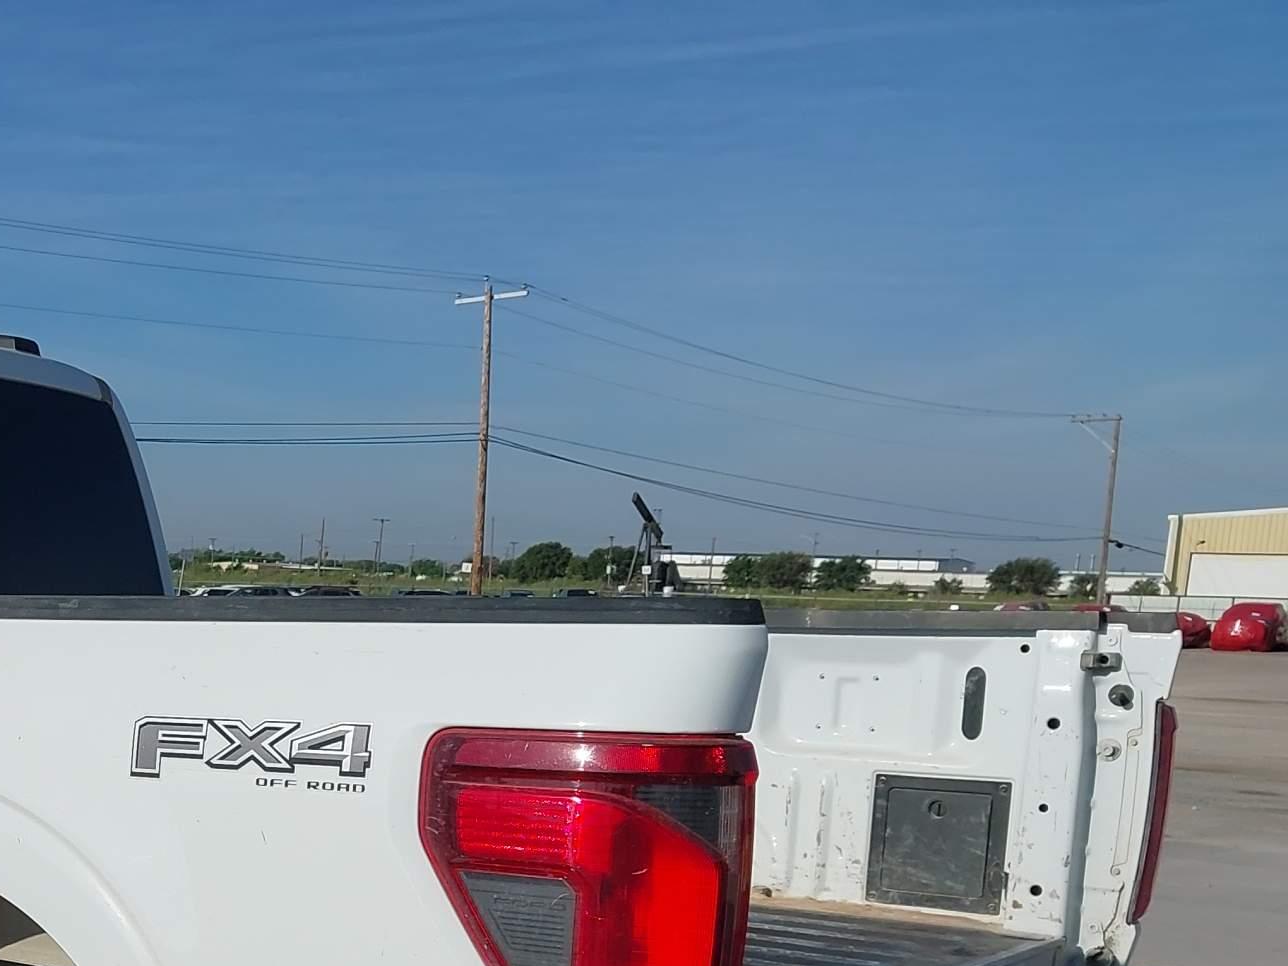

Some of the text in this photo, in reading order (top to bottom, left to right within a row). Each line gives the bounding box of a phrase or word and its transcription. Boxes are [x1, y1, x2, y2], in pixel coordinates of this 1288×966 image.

[129, 715, 373, 779] FX4
[255, 777, 366, 793] OFF ROAD
